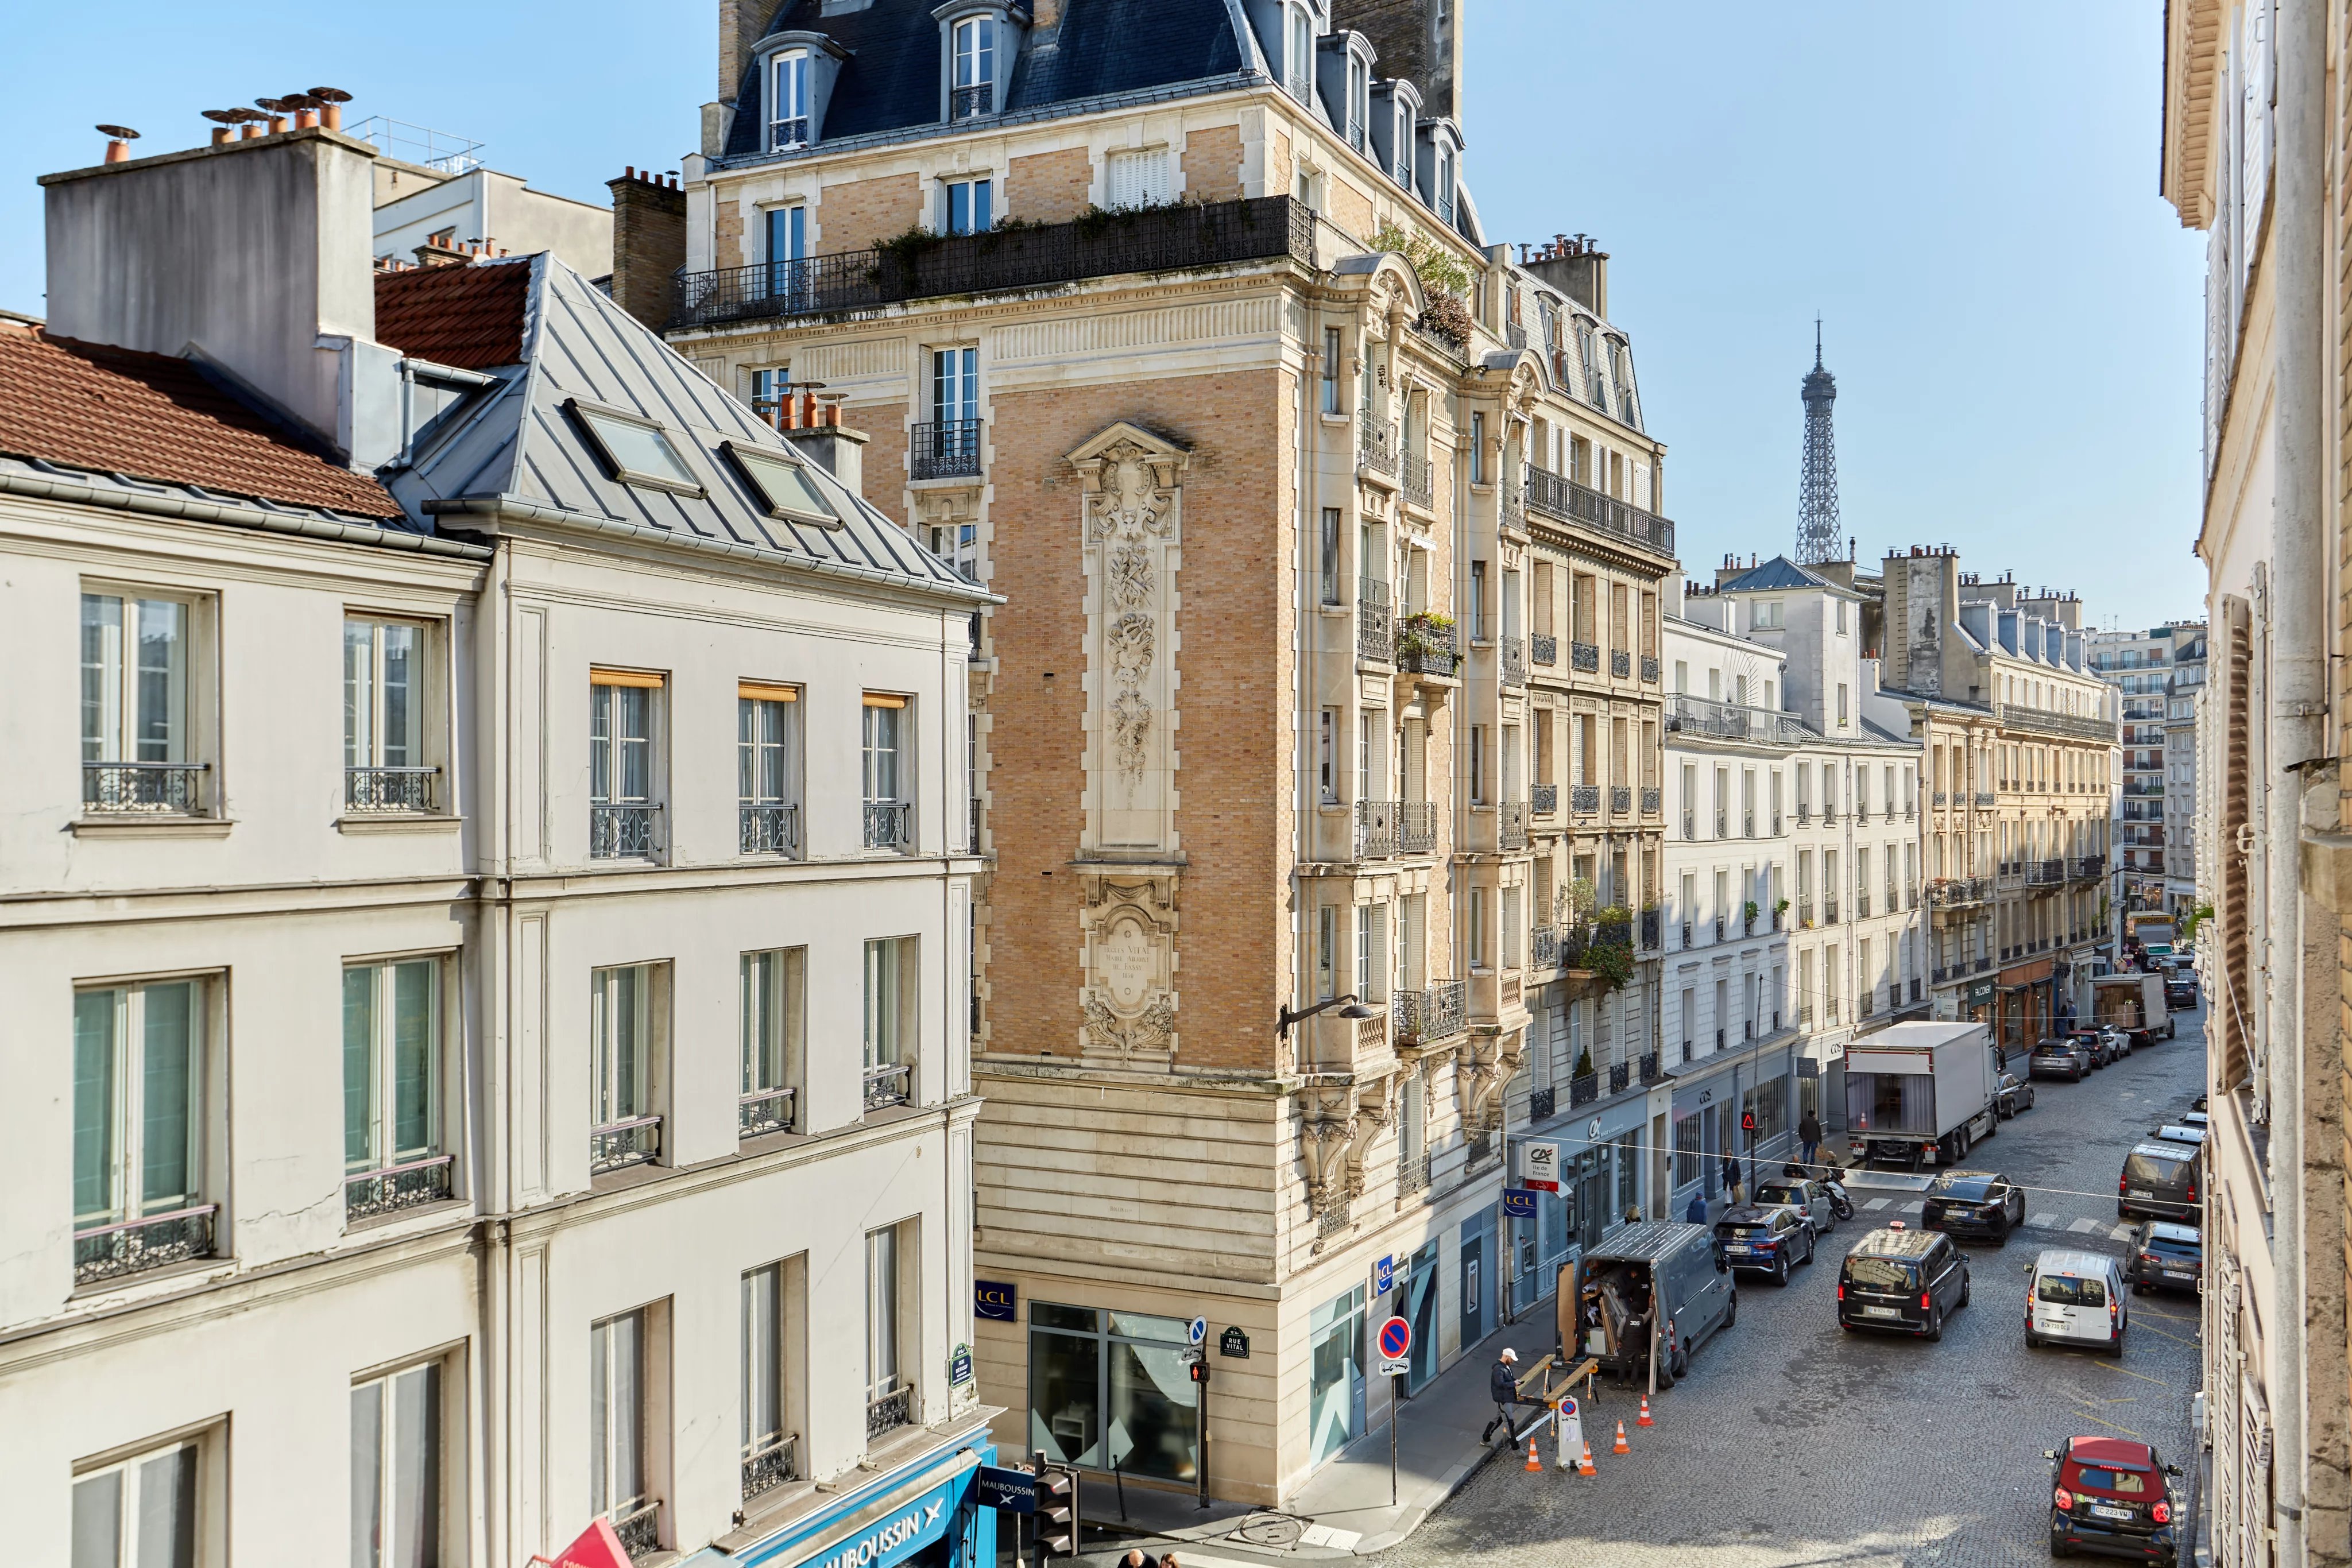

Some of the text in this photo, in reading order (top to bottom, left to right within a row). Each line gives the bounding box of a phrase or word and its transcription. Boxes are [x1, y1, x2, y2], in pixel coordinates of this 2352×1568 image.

[1128, 945, 1150, 954] VITAL
[1831, 1042, 1842, 1054] COS
[1699, 1089, 1711, 1104] COS
[1506, 1195, 1534, 1206] LCL
[1379, 1264, 1391, 1280] LCL
[978, 1290, 1010, 1304] LCL
[1226, 1343, 1243, 1351] VITAL
[981, 1480, 1035, 1497] MAUBOUSSIN
